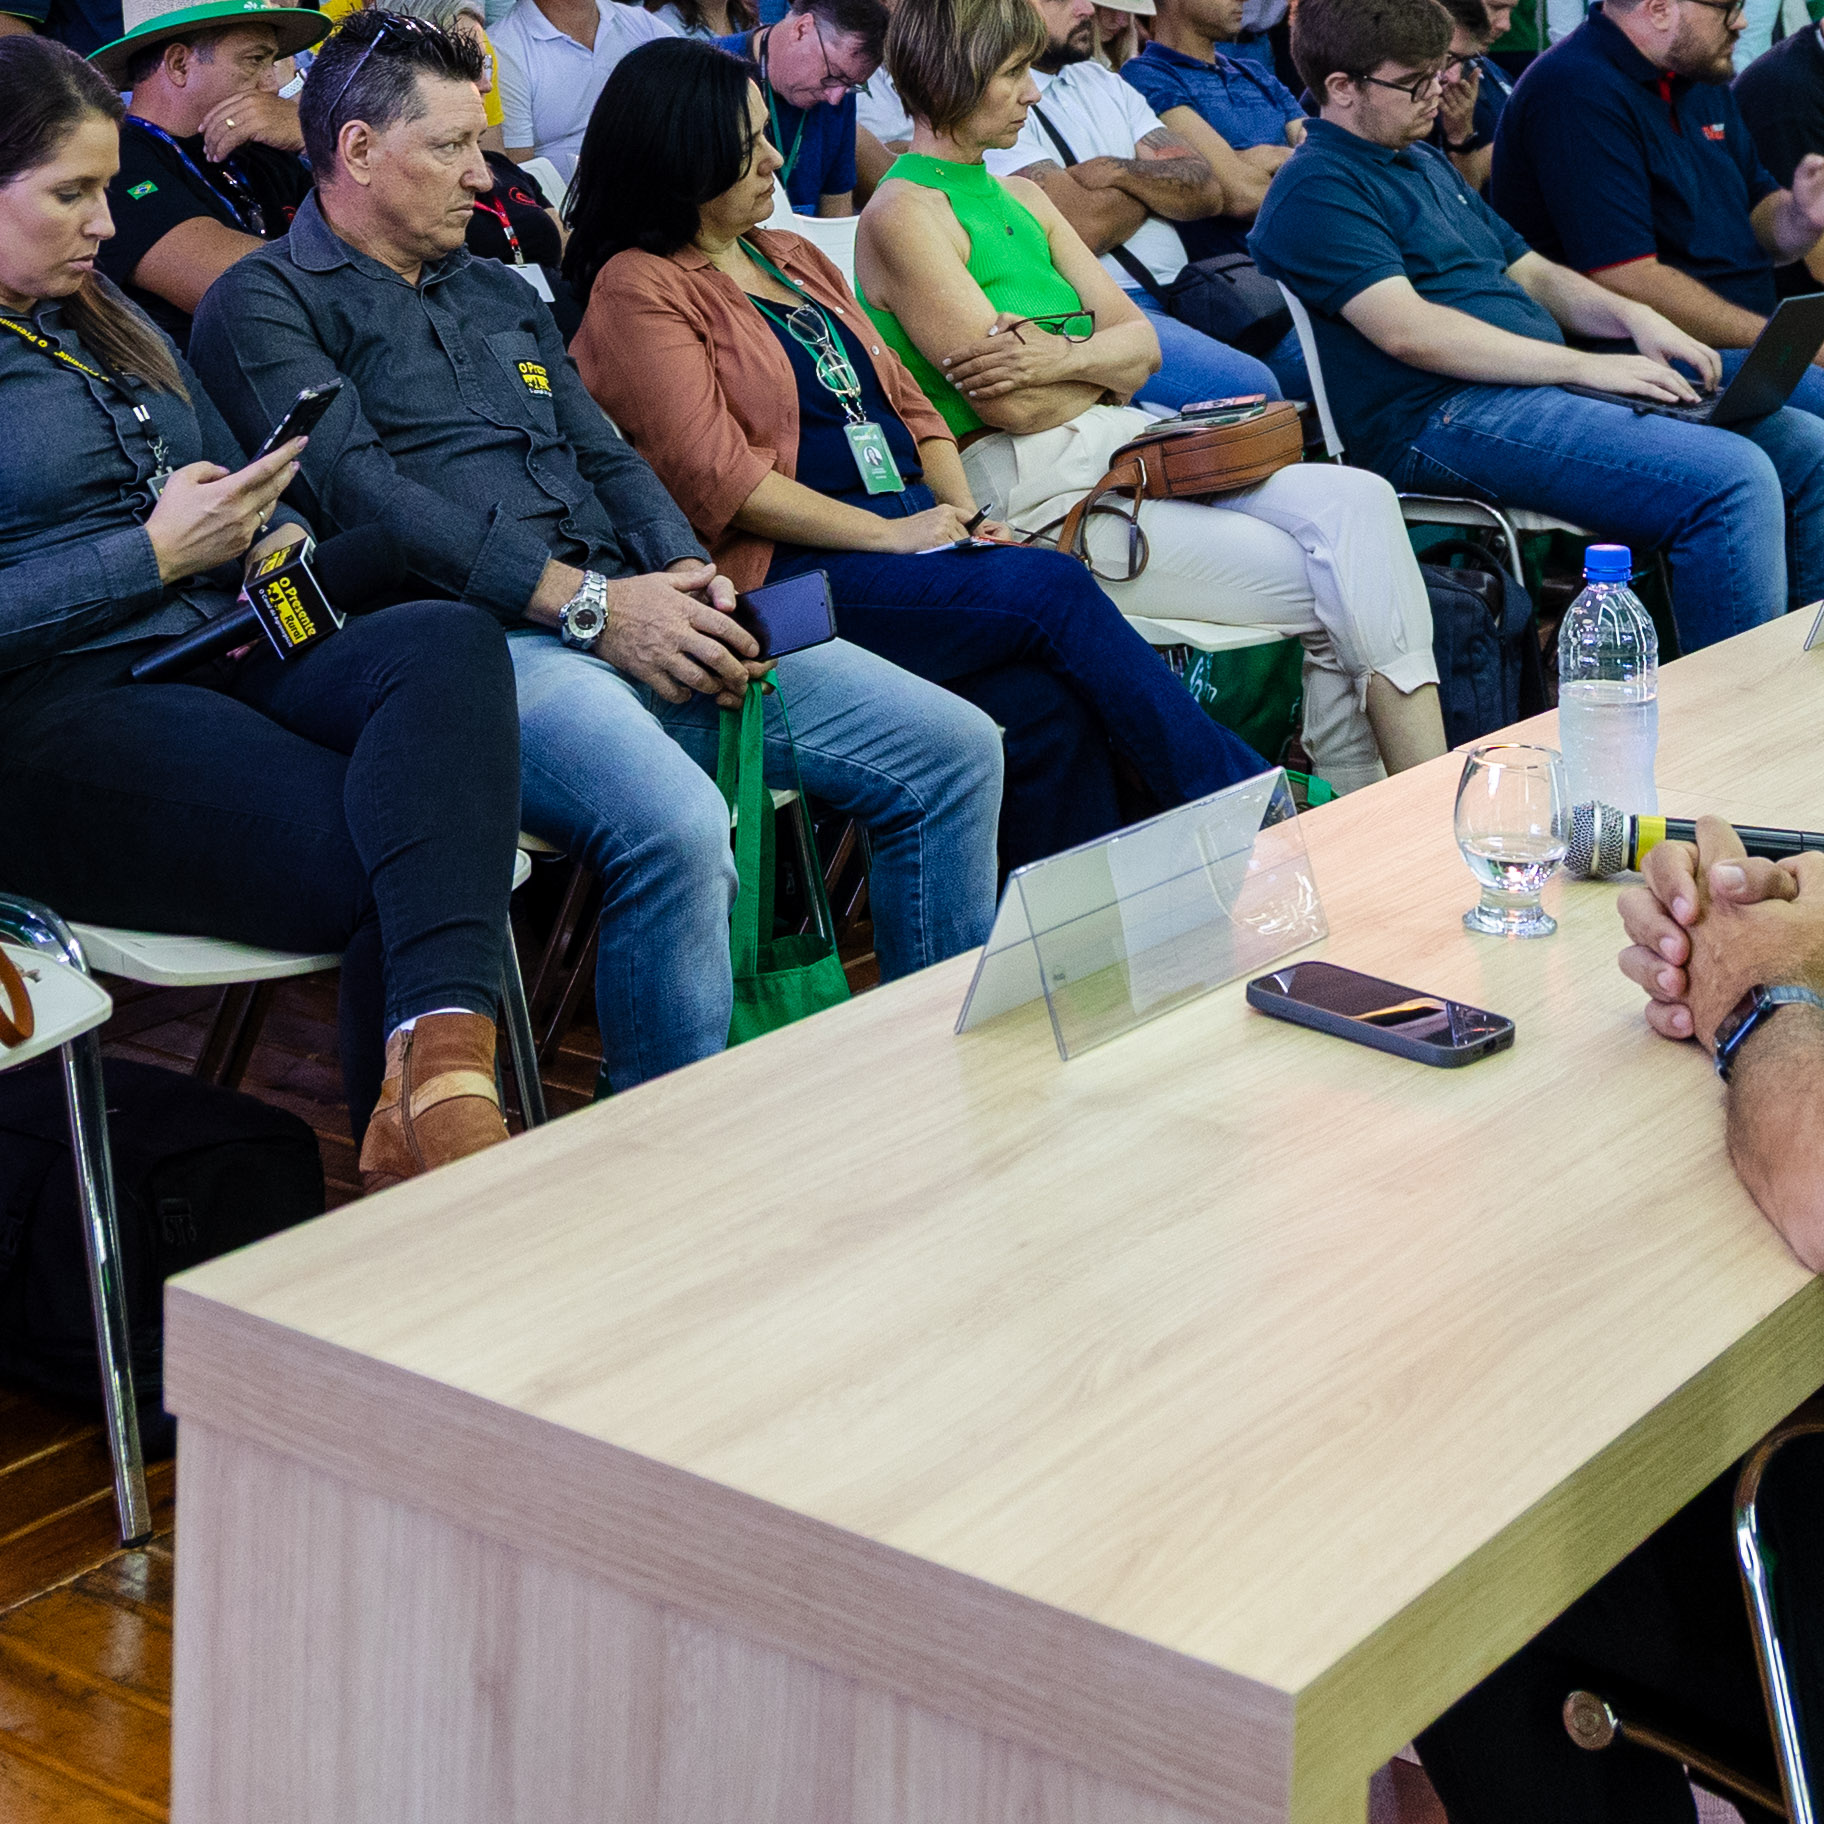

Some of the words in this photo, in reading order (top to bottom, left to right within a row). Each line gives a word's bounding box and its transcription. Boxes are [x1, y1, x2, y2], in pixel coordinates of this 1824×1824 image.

[280, 577, 290, 587] O
[285, 587, 317, 636] Presente
[284, 615, 303, 639] Rural
